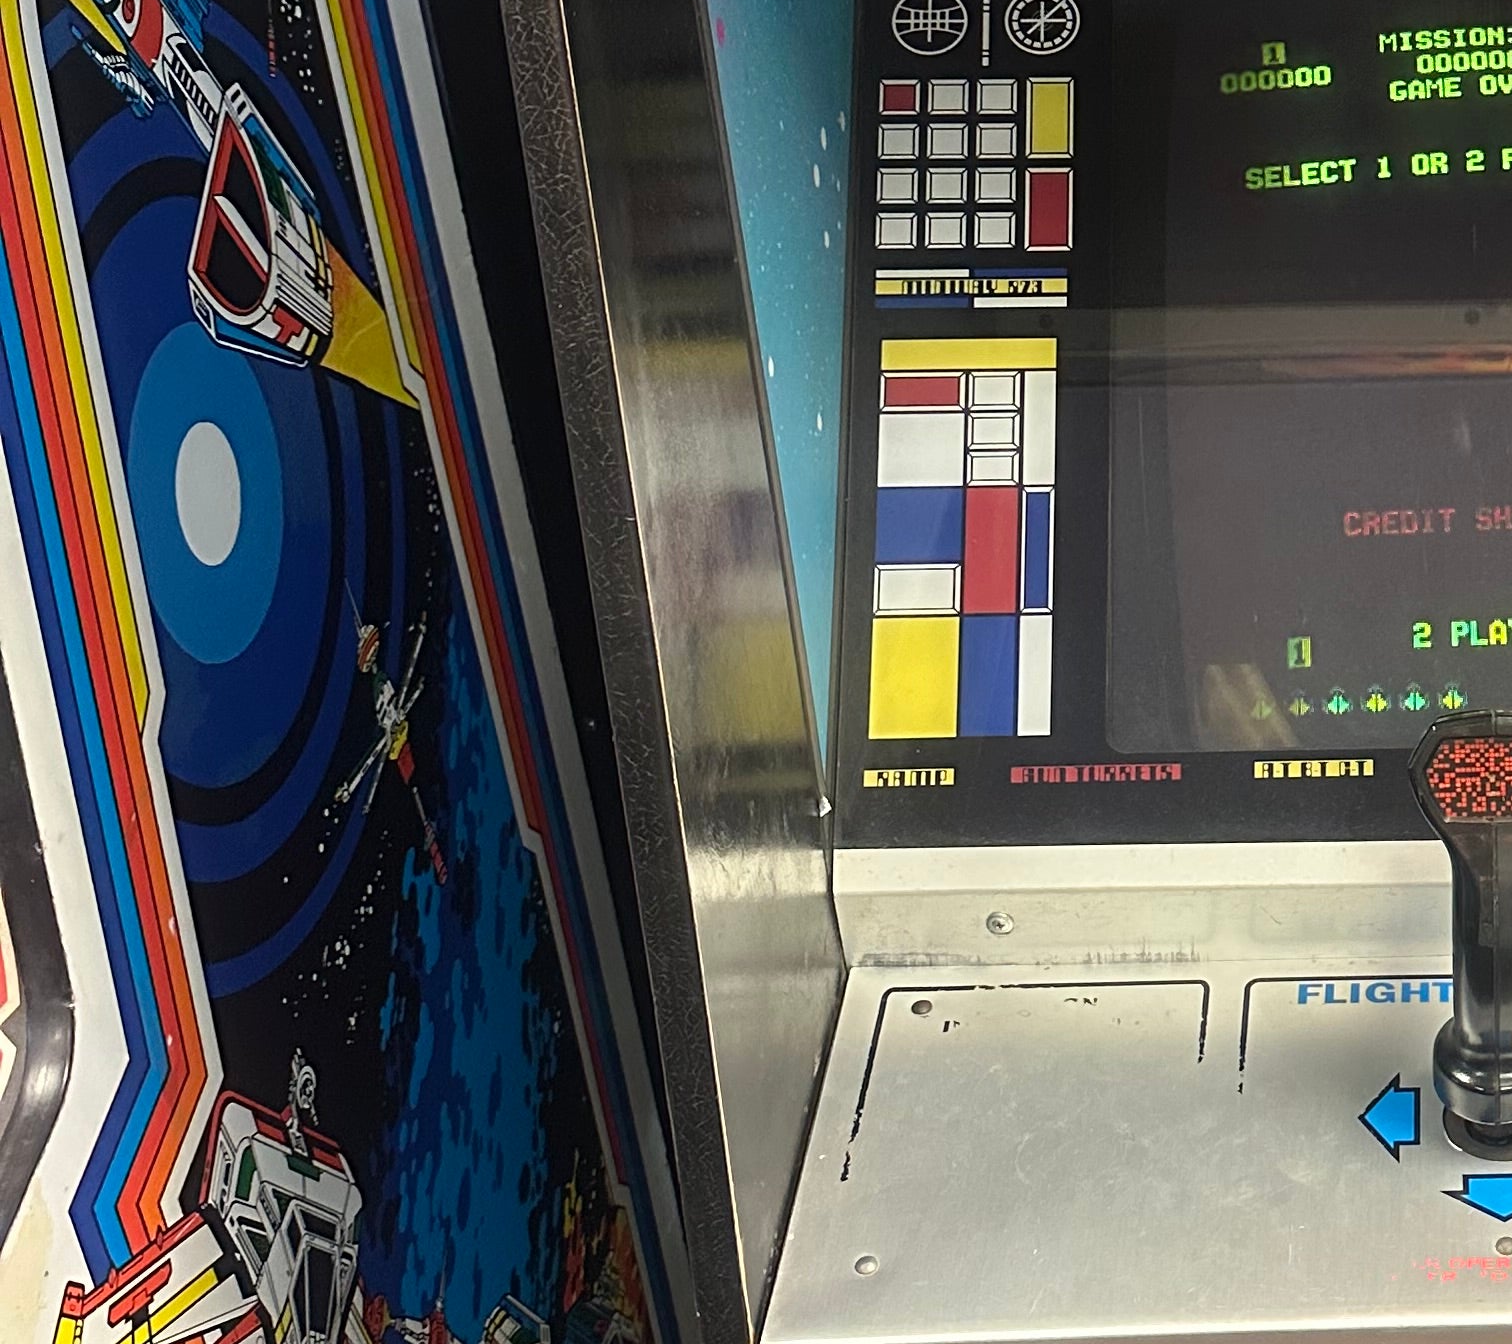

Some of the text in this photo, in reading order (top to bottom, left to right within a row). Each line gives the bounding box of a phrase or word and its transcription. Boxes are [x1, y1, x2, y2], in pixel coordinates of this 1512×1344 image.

[1220, 65, 1332, 94] 000000
[1388, 75, 1462, 102] GAME
[1244, 158, 1357, 190] SELECT
[1376, 156, 1392, 179] 1
[1411, 151, 1449, 176] OR
[1465, 149, 1486, 173] 2
[1342, 507, 1457, 537] CREDIT
[1411, 622, 1433, 649] 2
[1296, 981, 1453, 1006] FLIGHT
